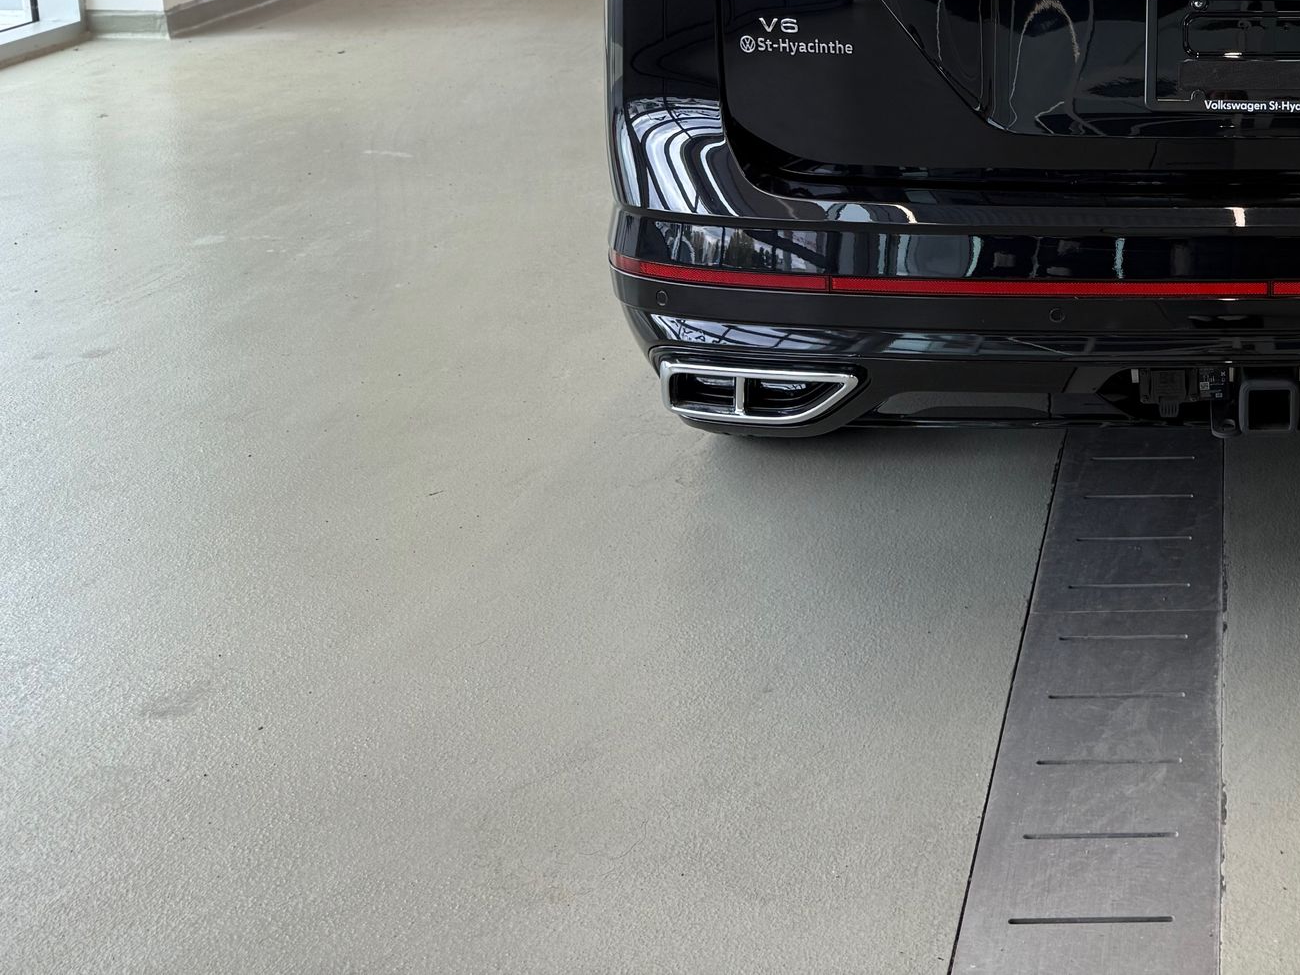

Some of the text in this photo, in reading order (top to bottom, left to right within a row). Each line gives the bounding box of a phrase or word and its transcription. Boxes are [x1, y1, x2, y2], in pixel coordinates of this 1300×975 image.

[758, 17, 799, 33] V6
[757, 37, 853, 56] St-Hyacinthe
[1204, 99, 1267, 112] Volkswagen
